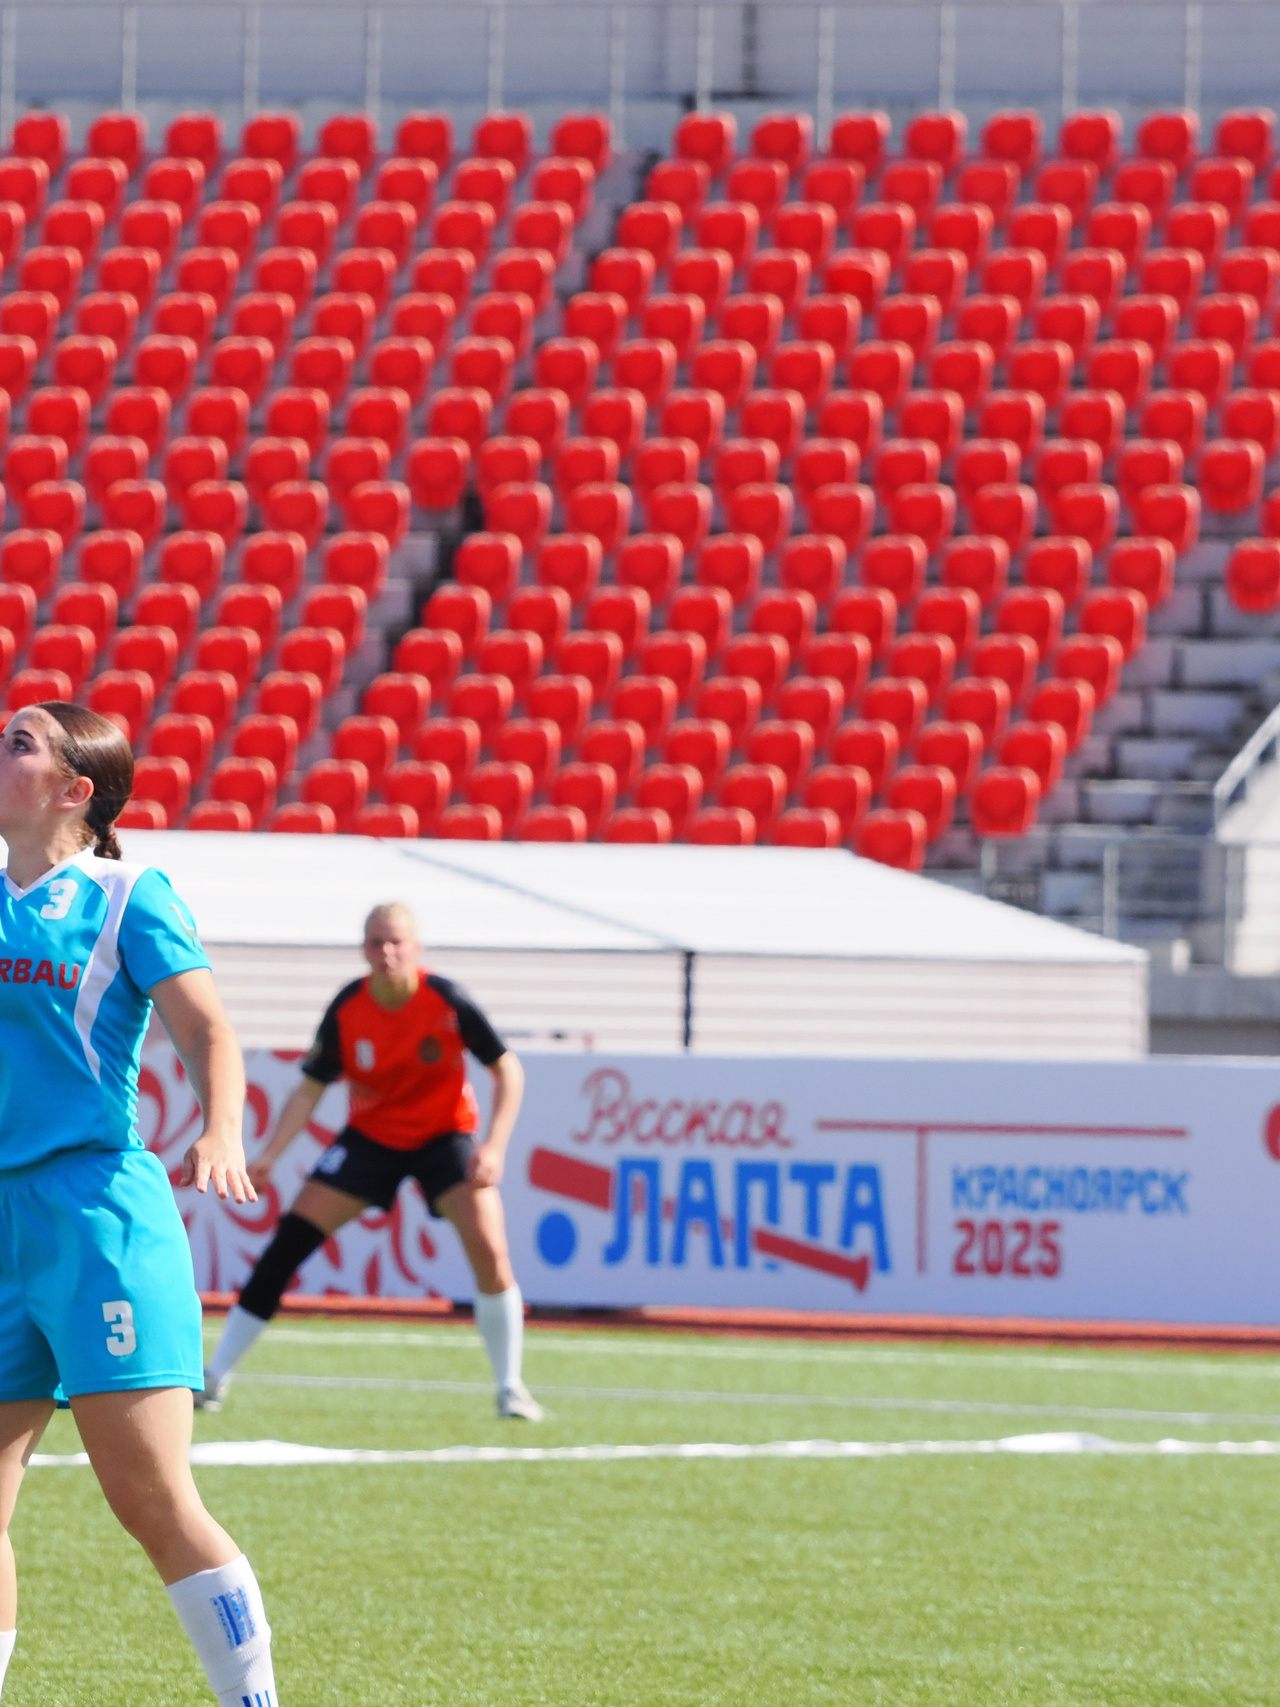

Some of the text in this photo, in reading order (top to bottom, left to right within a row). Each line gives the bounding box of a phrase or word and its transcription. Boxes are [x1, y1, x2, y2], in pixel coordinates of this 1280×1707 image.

[40, 878, 78, 919] 3
[603, 1157, 892, 1274] ЛАПТА
[952, 1165, 1190, 1214] КРАСНОЯРСК
[952, 1219, 1062, 1277] 2025
[102, 1300, 137, 1356] 3
